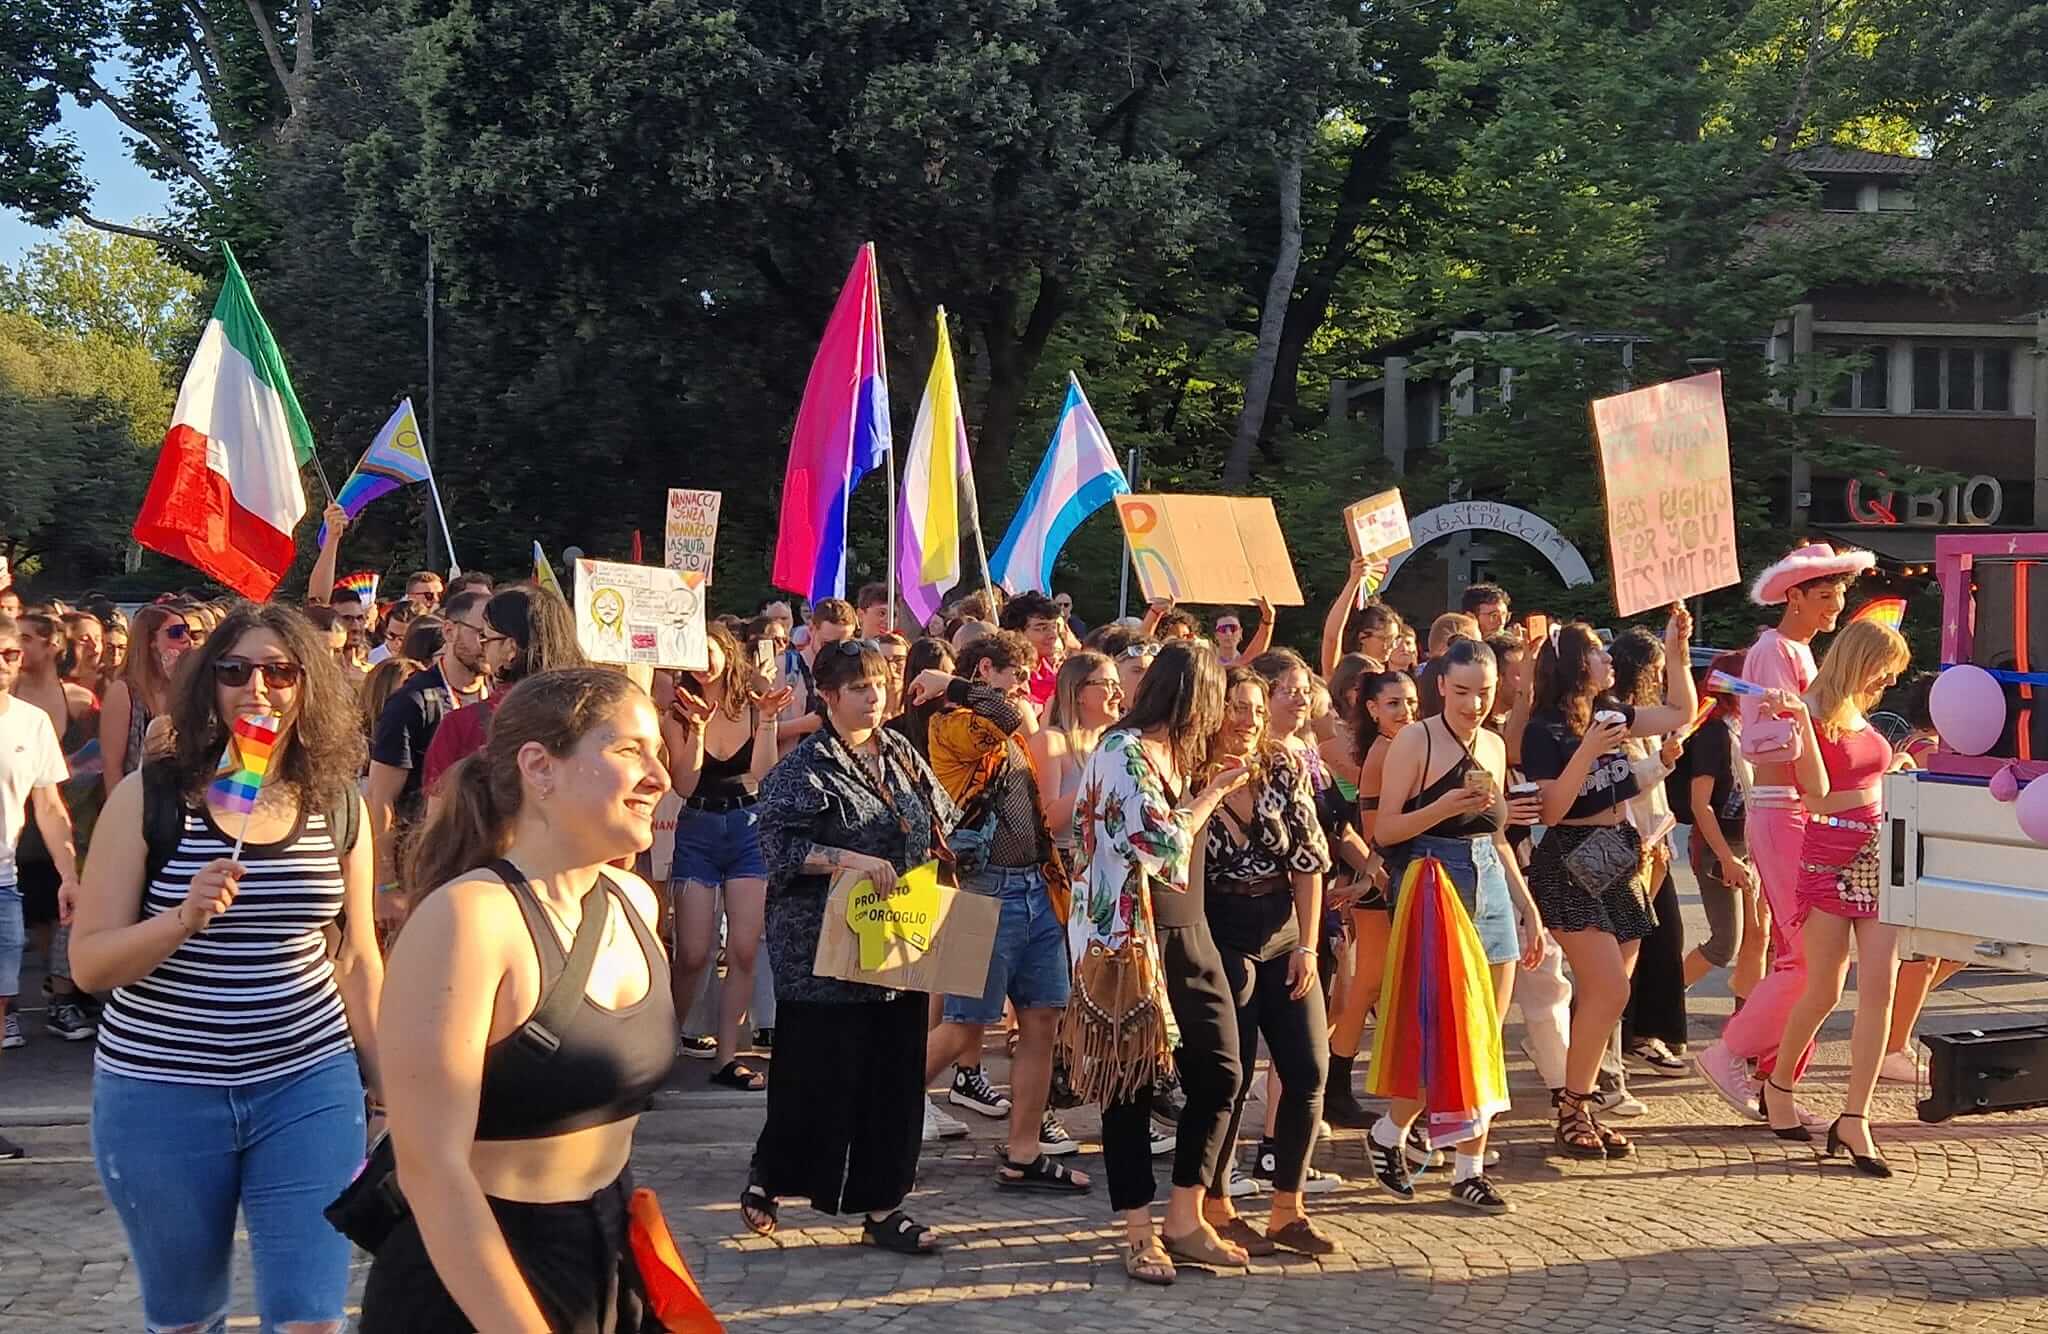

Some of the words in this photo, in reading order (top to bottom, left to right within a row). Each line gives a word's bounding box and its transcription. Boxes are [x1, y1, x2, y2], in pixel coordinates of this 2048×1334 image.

[672, 552, 700, 568] STO
[1661, 551, 1697, 601] NOT
[855, 884, 911, 909] PROTSTO
[868, 908, 928, 925] ORGOGLIO
